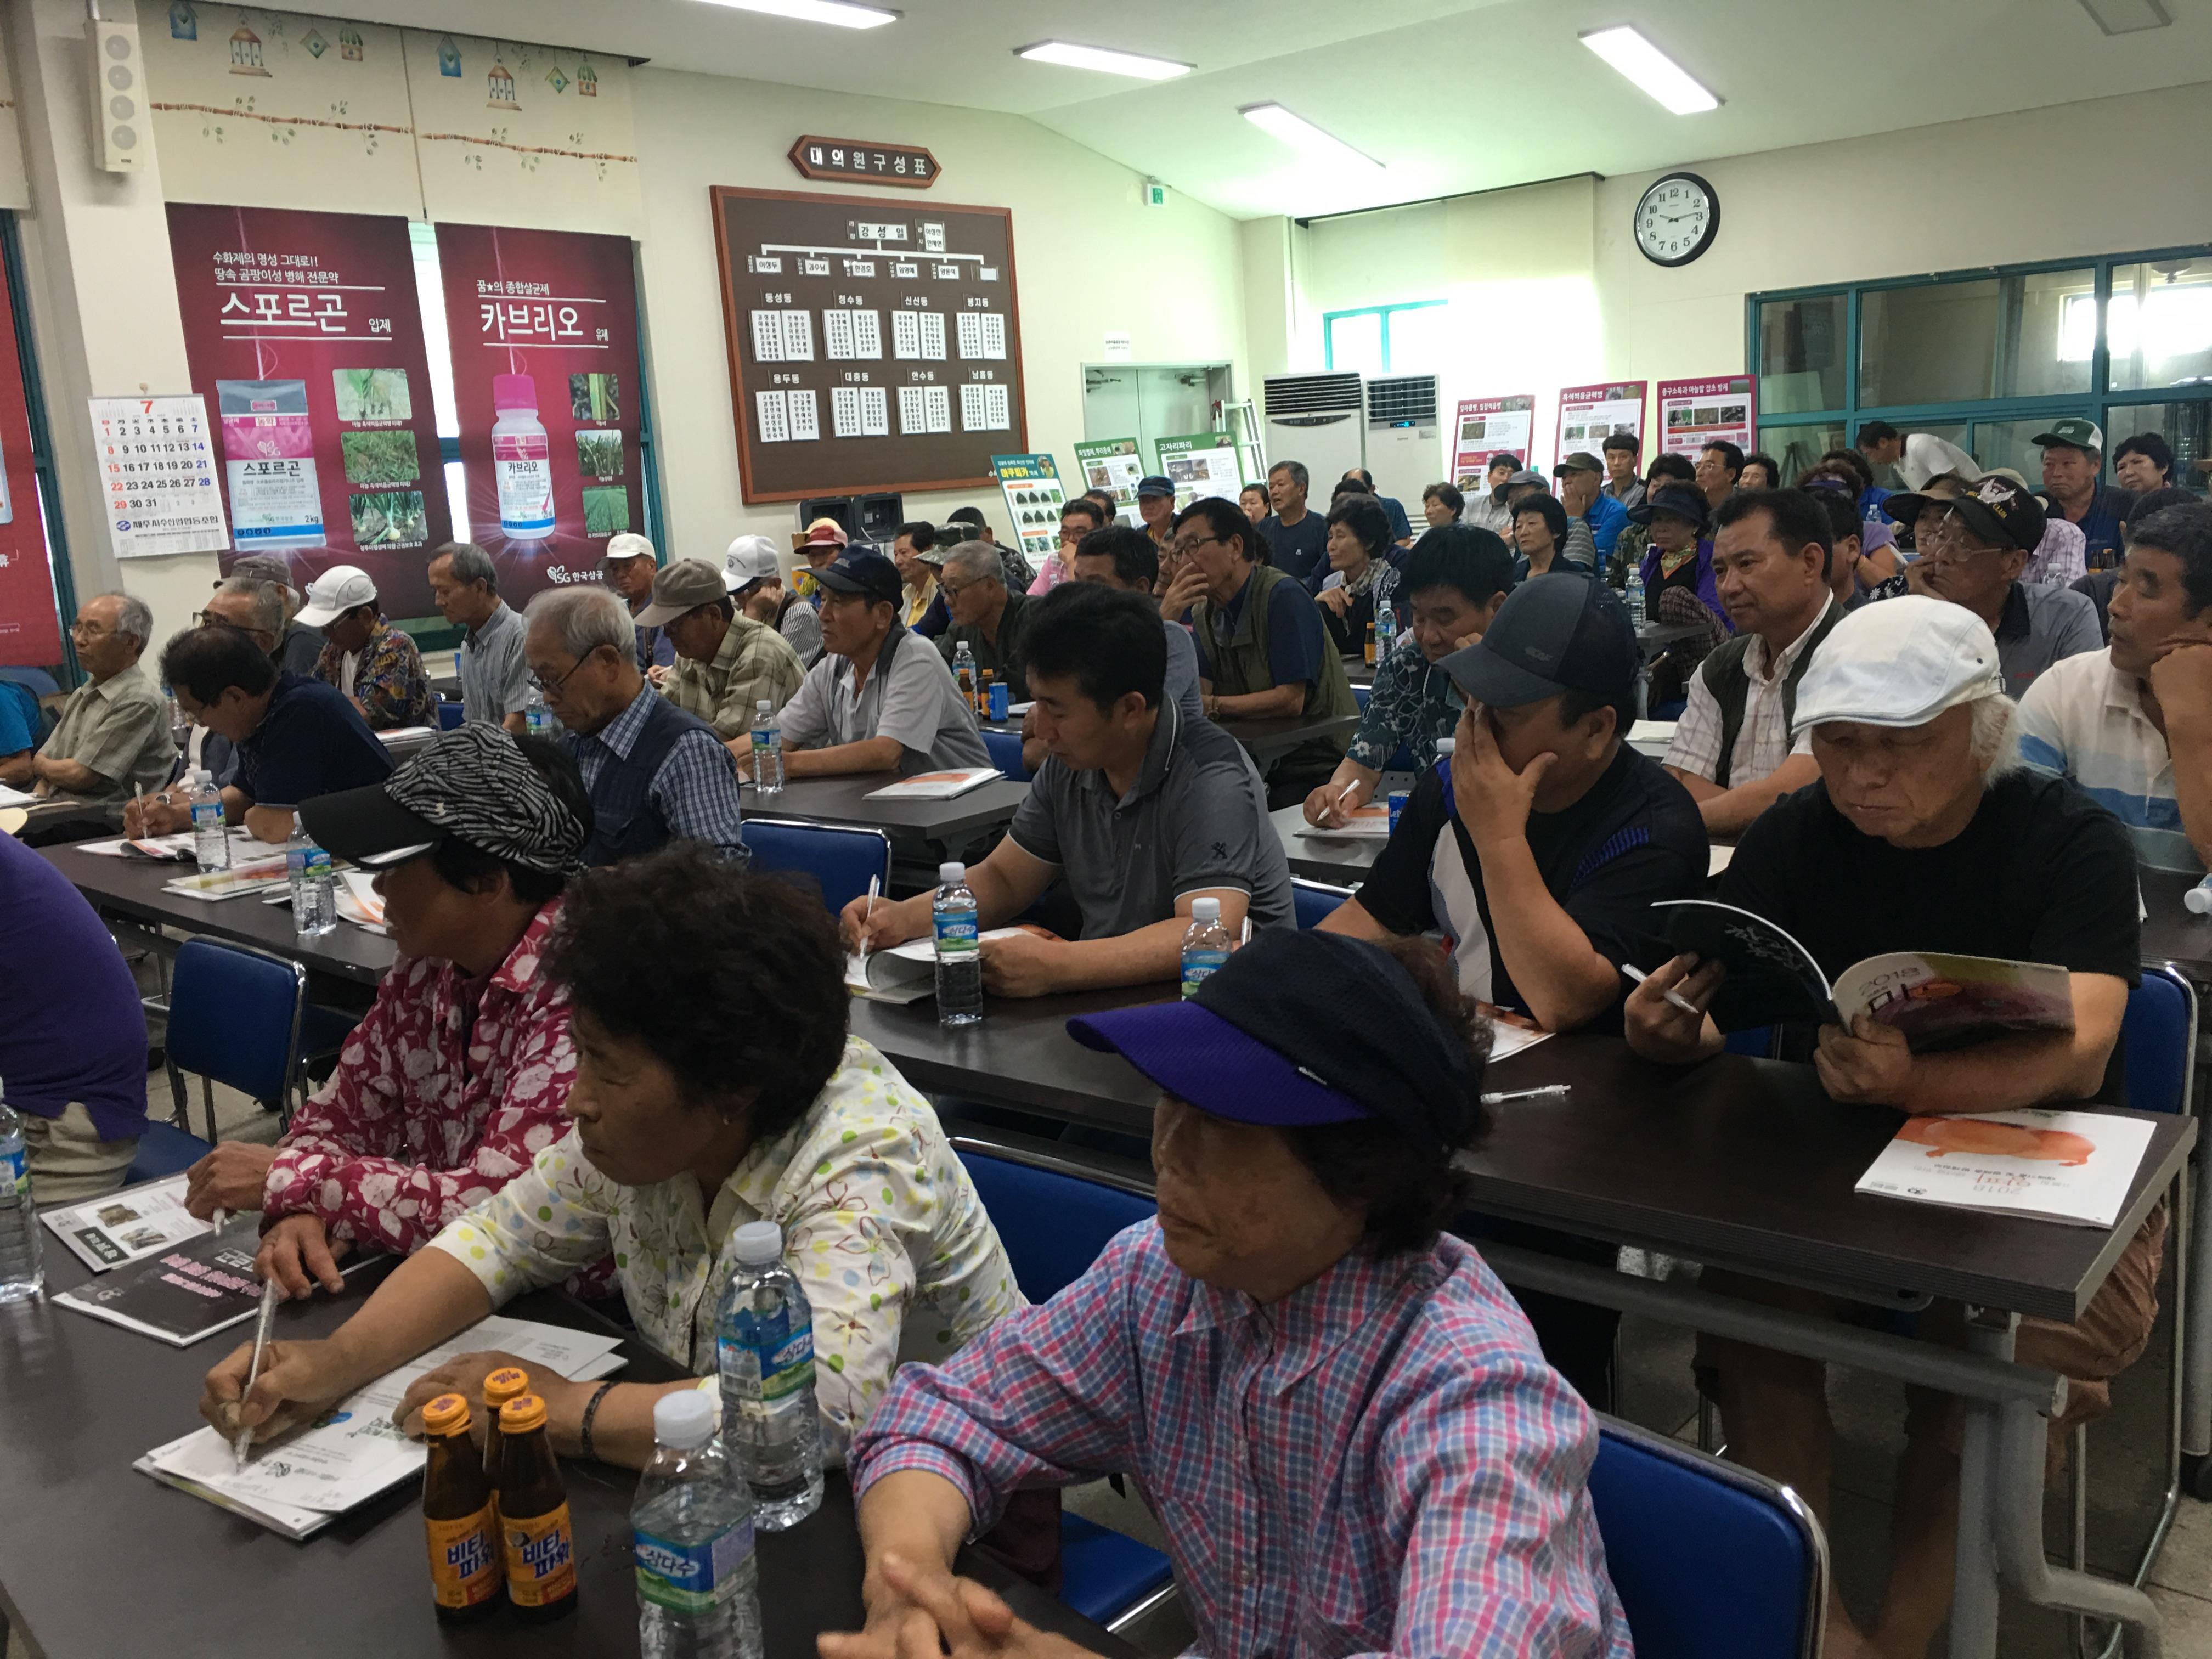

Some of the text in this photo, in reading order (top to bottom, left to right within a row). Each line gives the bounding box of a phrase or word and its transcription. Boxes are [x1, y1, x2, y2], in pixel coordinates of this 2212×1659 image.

[1659, 193, 1666, 202] 11
[1670, 188, 1679, 198] 12
[1693, 199, 1700, 208] 2
[1649, 205, 1657, 214] 10
[1696, 212, 1703, 221] 3
[1646, 218, 1653, 228] 9
[1691, 225, 1699, 235] 4
[1650, 232, 1656, 240] 8
[1683, 237, 1690, 246] 5
[1659, 241, 1666, 250] 7
[1671, 242, 1678, 251] 6
[213, 251, 318, 267] 수화제의 명성 그대로!!
[215, 268, 338, 284] 땅속 곰팡이성 병해 전문약
[506, 281, 549, 295] 종합살균제
[220, 292, 391, 332] 스포르곤 입제
[481, 302, 608, 341] 카브리오 유제
[1717, 383, 1728, 392] 방제
[140, 400, 153, 414] 7
[105, 428, 110, 436] 1
[120, 427, 126, 436] 2
[134, 426, 141, 435] 3
[149, 426, 155, 434] 4
[163, 425, 170, 433] 5
[178, 425, 184, 433] 6
[108, 446, 114, 454] 8
[122, 445, 129, 454] 9
[135, 444, 146, 454] 10
[150, 444, 161, 452] 11
[178, 443, 190, 451] 13
[192, 443, 204, 451] 14
[1159, 441, 1192, 451] 고자리파리
[108, 460, 207, 473] 15 16 17 18 19 20 21
[243, 461, 301, 476] 스포르곤
[508, 462, 538, 474] 카브리오
[111, 478, 211, 491] 22 23 24 25 26 27 28
[114, 501, 127, 509] 29
[129, 500, 142, 509] 30
[145, 499, 157, 507] 31
[1993, 503, 2007, 518] CLUB
[572, 571, 603, 582] 한국삼공
[447, 1530, 485, 1566] 비타
[522, 1530, 560, 1564] 비타
[534, 1537, 569, 1578] 파워
